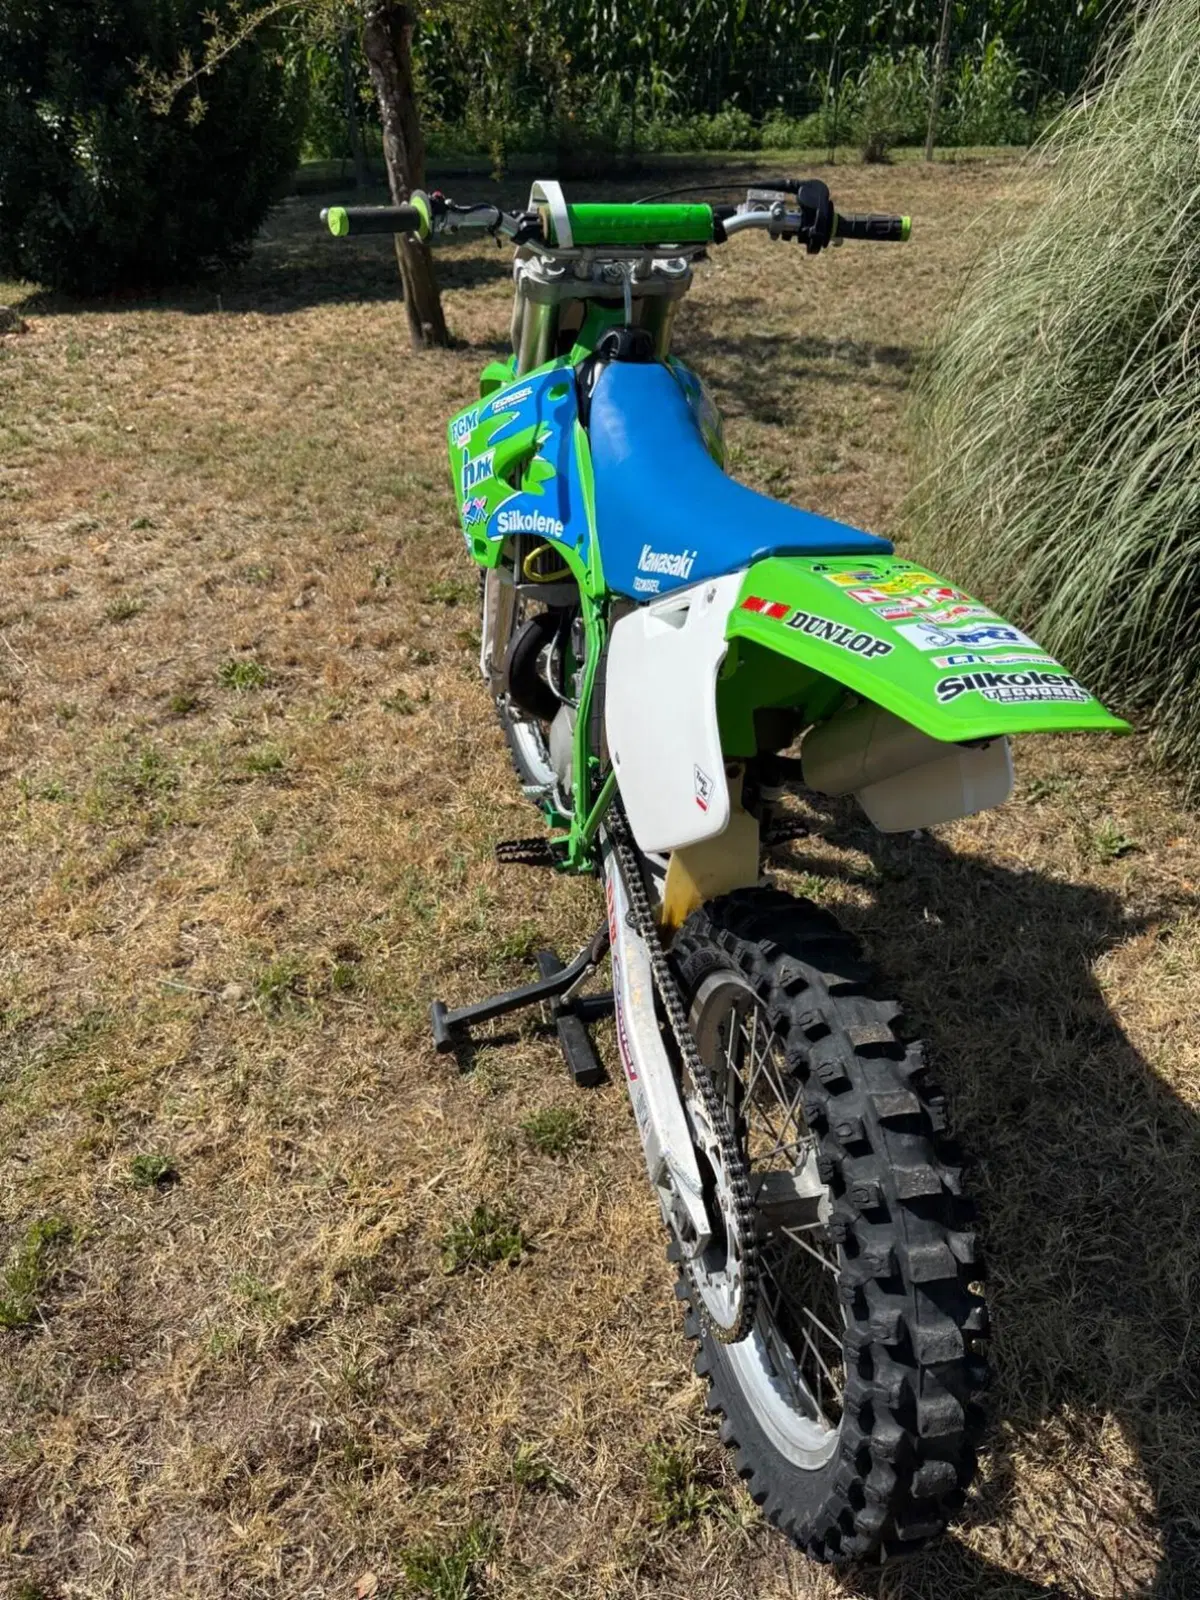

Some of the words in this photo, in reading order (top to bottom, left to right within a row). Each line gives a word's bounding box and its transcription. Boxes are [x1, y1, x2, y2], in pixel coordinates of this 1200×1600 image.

[497, 509, 564, 538] Silkolene
[637, 543, 698, 580] Kawasaki
[786, 611, 893, 658] DUNLOP
